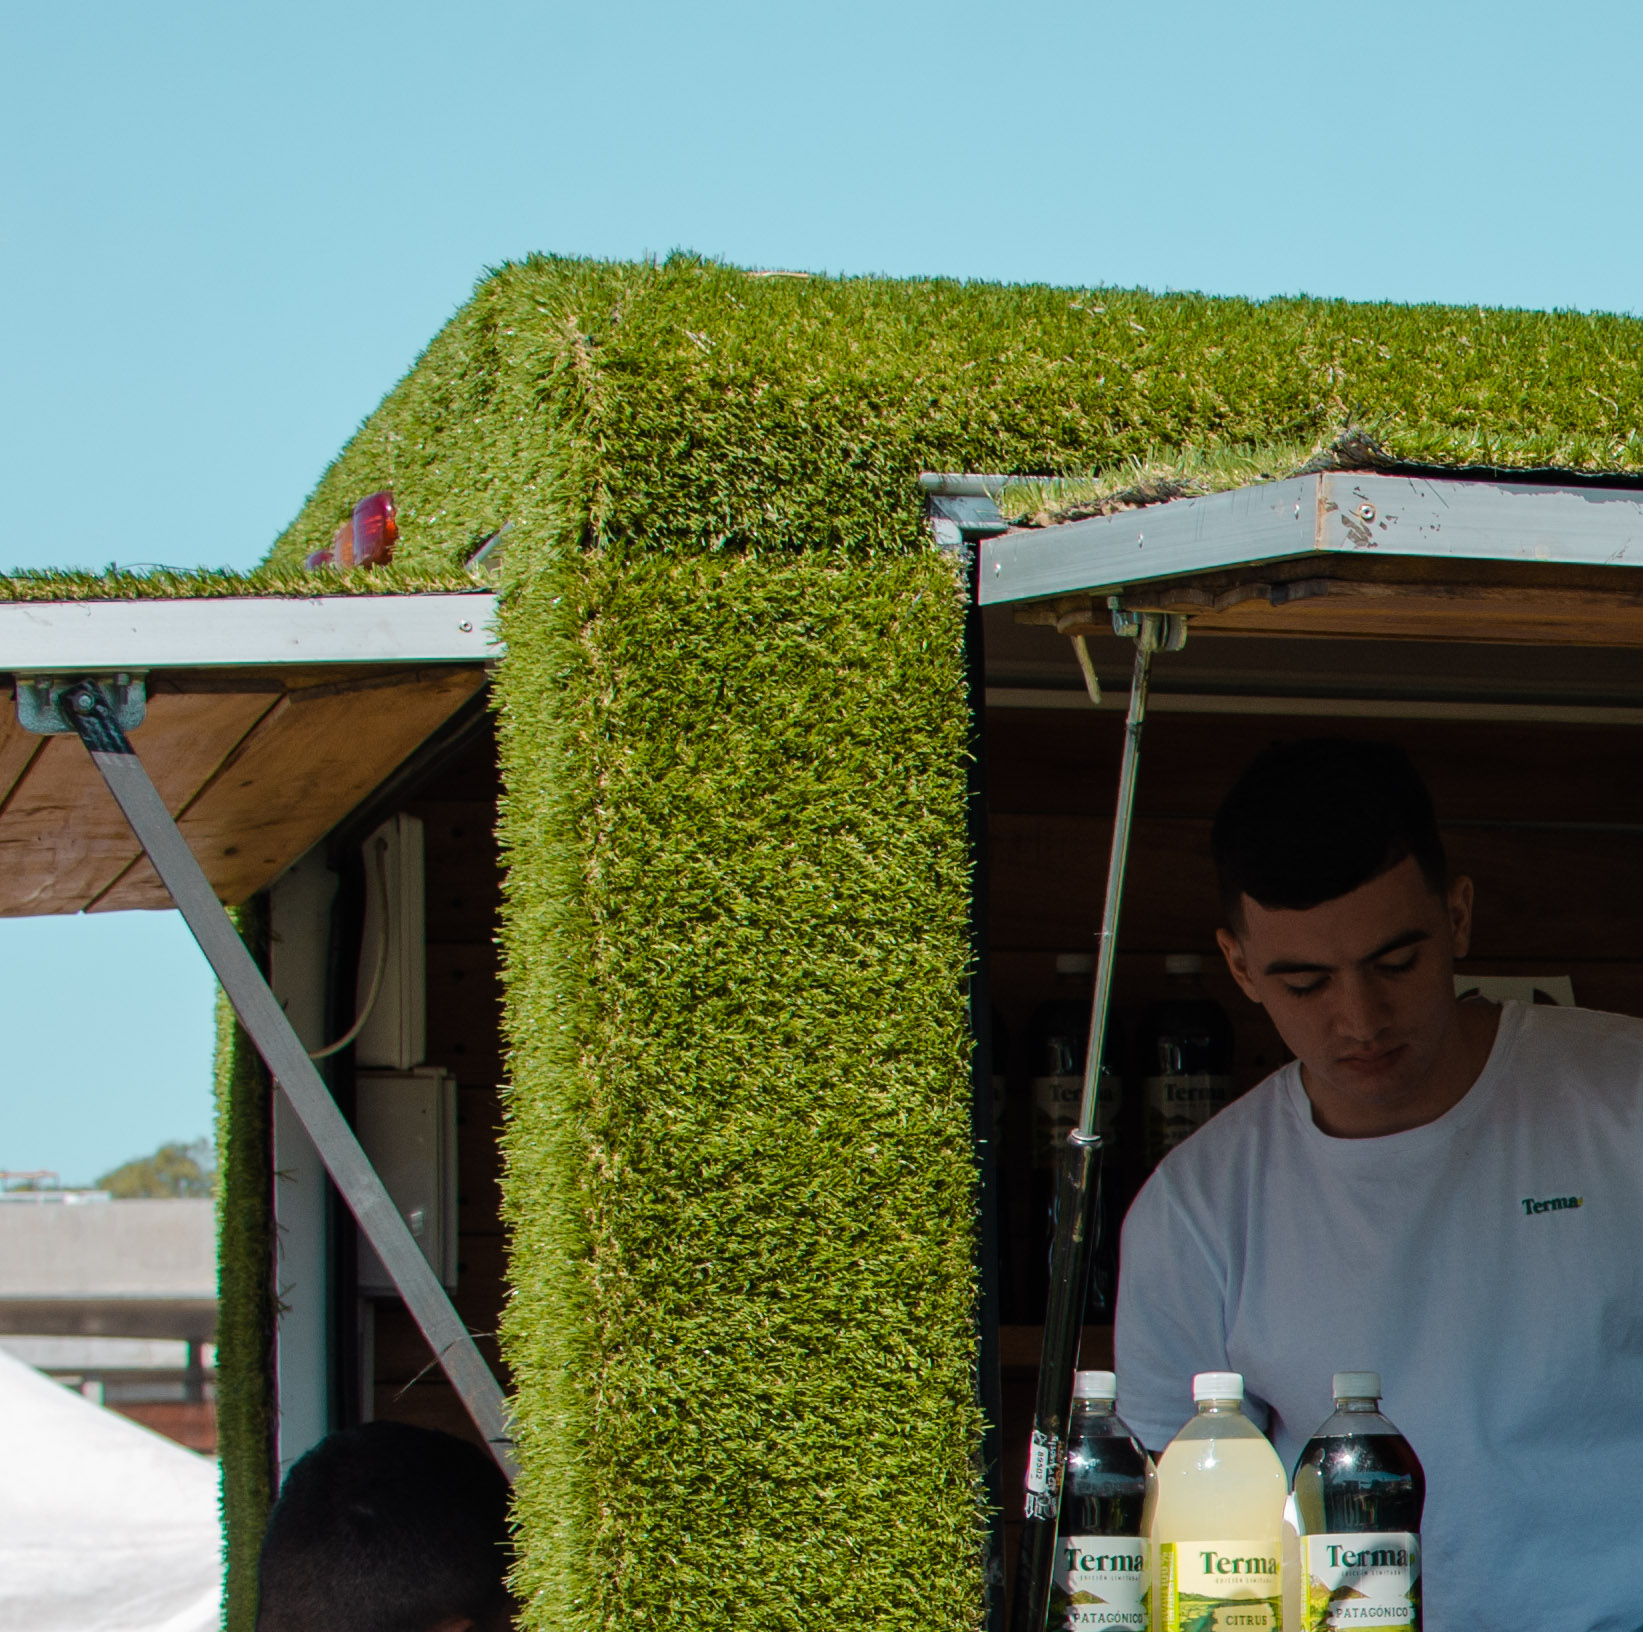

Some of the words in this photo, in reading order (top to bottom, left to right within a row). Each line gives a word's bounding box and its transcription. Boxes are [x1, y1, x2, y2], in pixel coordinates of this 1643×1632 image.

[1049, 1084, 1113, 1101] Tera
[1522, 1196, 1579, 1215] Terma
[1064, 1548, 1144, 1572] Terma
[1199, 1551, 1278, 1575] Terma
[1326, 1544, 1408, 1568] Terma
[1073, 1611, 1143, 1624] PATAGÓNICO
[1335, 1604, 1409, 1618] PATAGÓNICO
[1225, 1615, 1268, 1626] CITRUS
